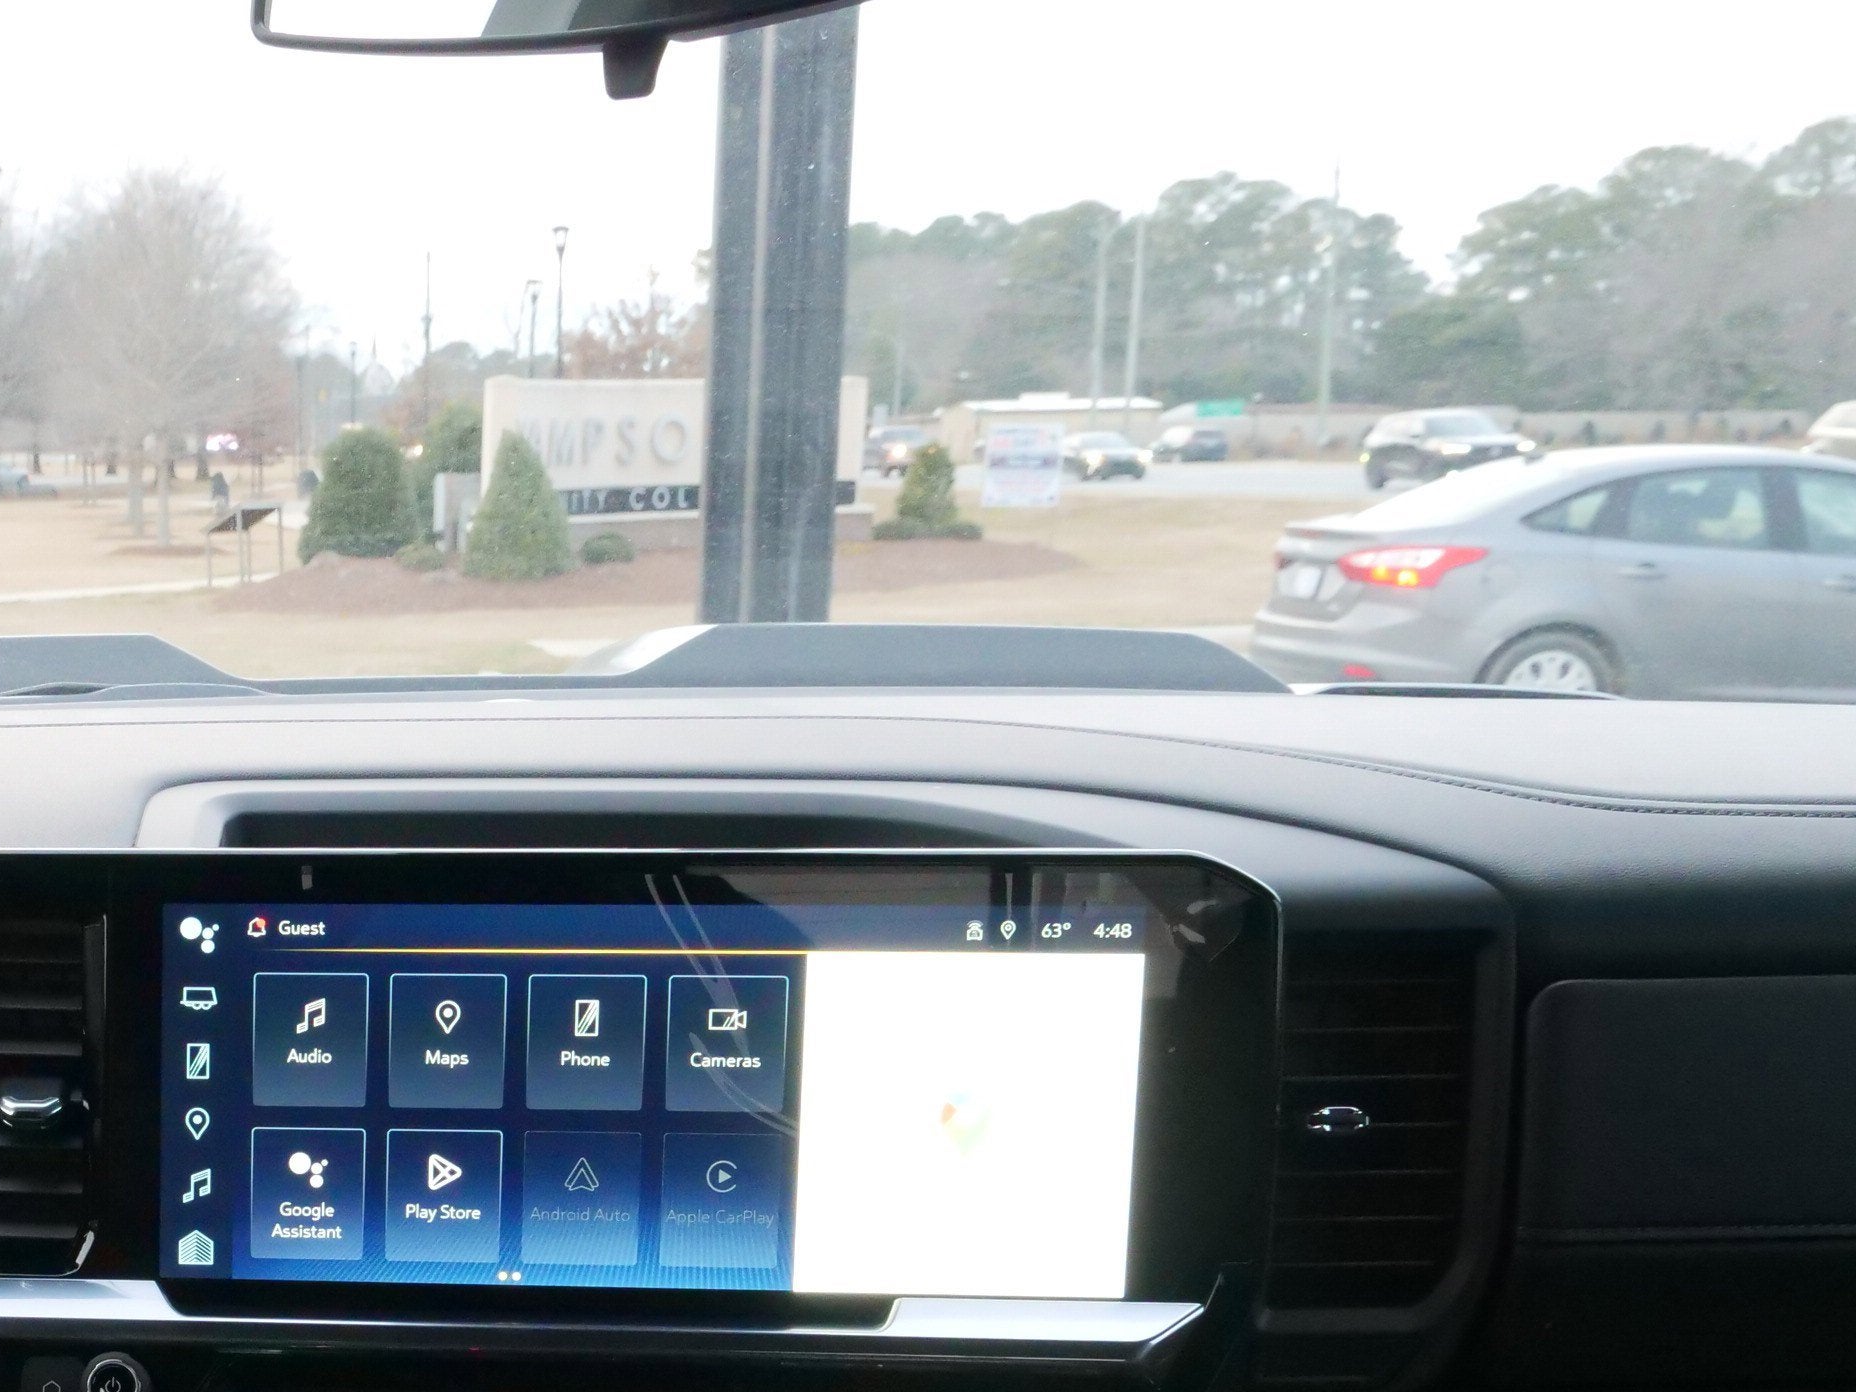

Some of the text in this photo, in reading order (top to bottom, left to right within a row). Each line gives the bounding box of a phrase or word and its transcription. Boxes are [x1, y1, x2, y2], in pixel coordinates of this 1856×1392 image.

[278, 920, 326, 936] Guest
[1093, 923, 1132, 938] 4:48
[286, 1048, 332, 1064] Audio
[425, 1050, 469, 1068] Maps
[560, 1050, 610, 1067] Phone
[690, 1052, 761, 1068] Cameras
[279, 1202, 335, 1221] Google
[405, 1203, 481, 1223] Play Store
[530, 1207, 630, 1222] Android Auto
[666, 1209, 775, 1228] Apple CarPlay
[271, 1224, 342, 1240] Assistant
